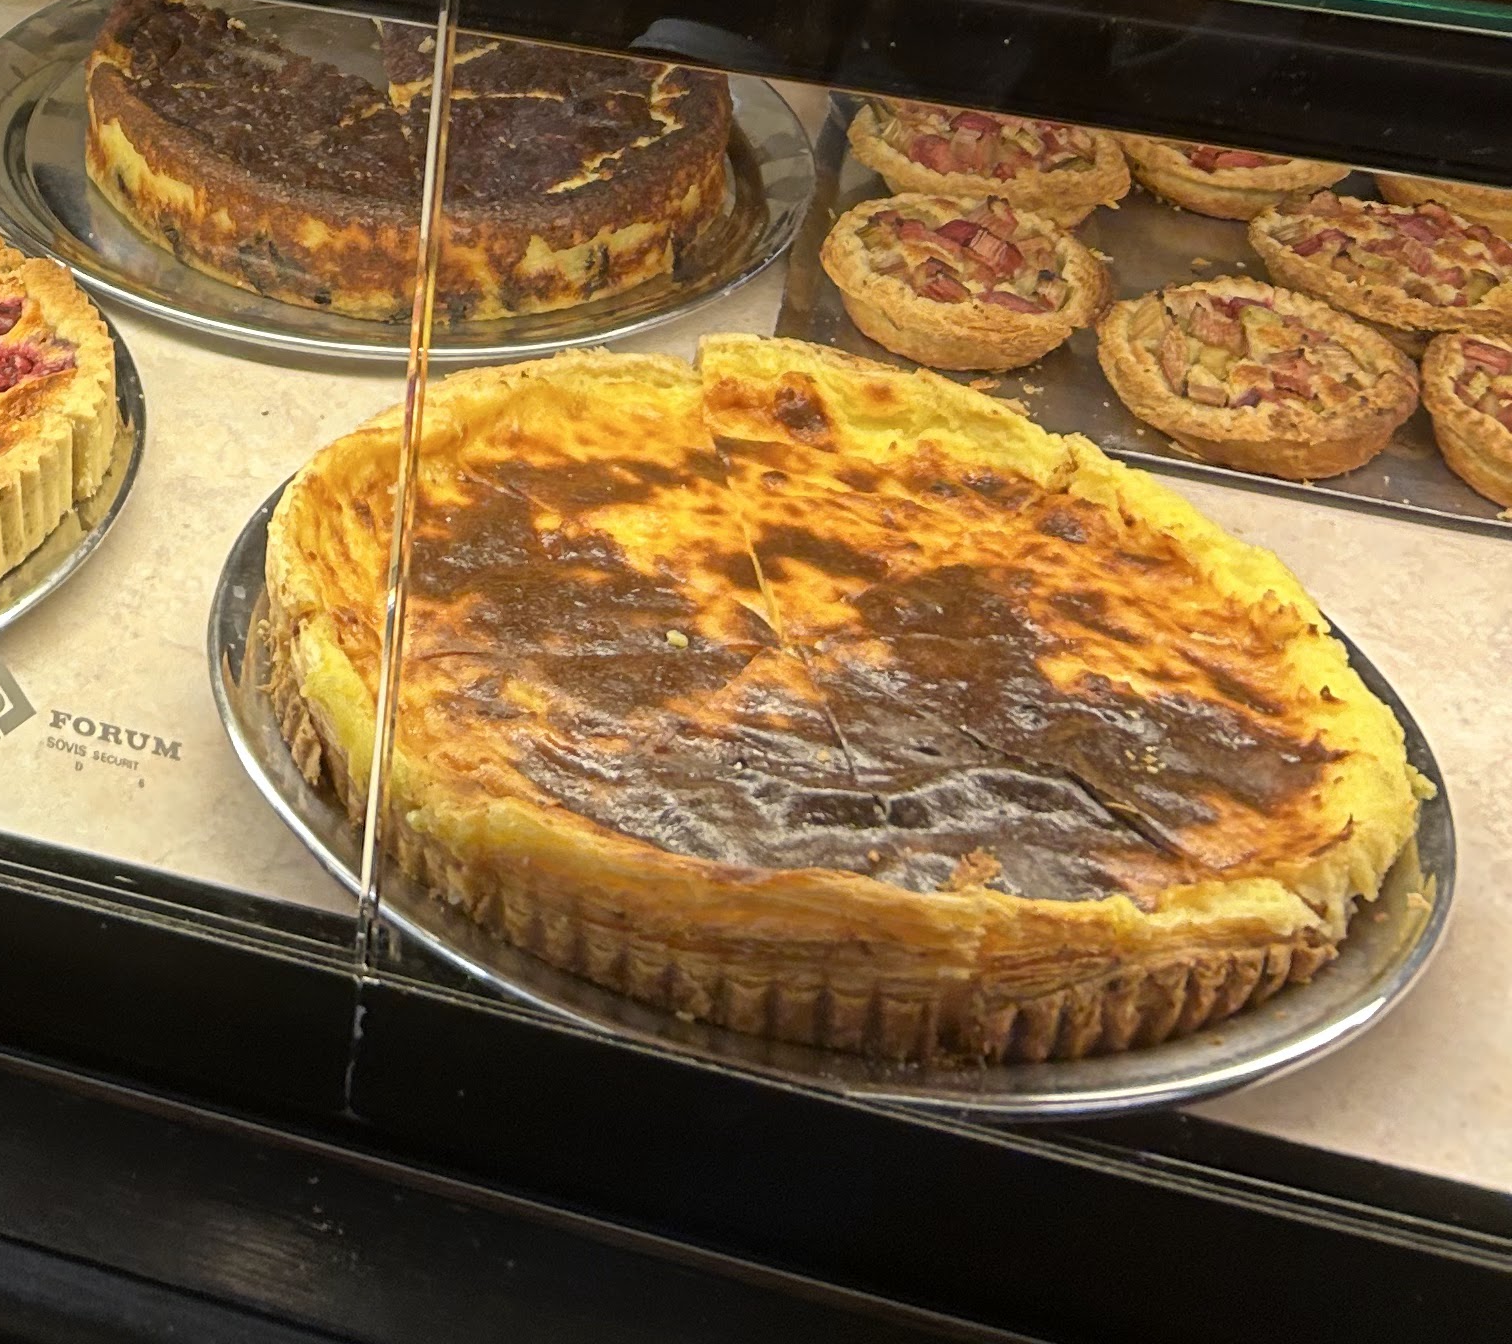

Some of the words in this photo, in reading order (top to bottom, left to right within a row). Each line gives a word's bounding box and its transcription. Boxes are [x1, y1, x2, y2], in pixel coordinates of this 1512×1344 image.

[46, 736, 87, 757] SOVIS
[92, 750, 139, 771] SECURIT
[49, 709, 183, 761] FORUM
